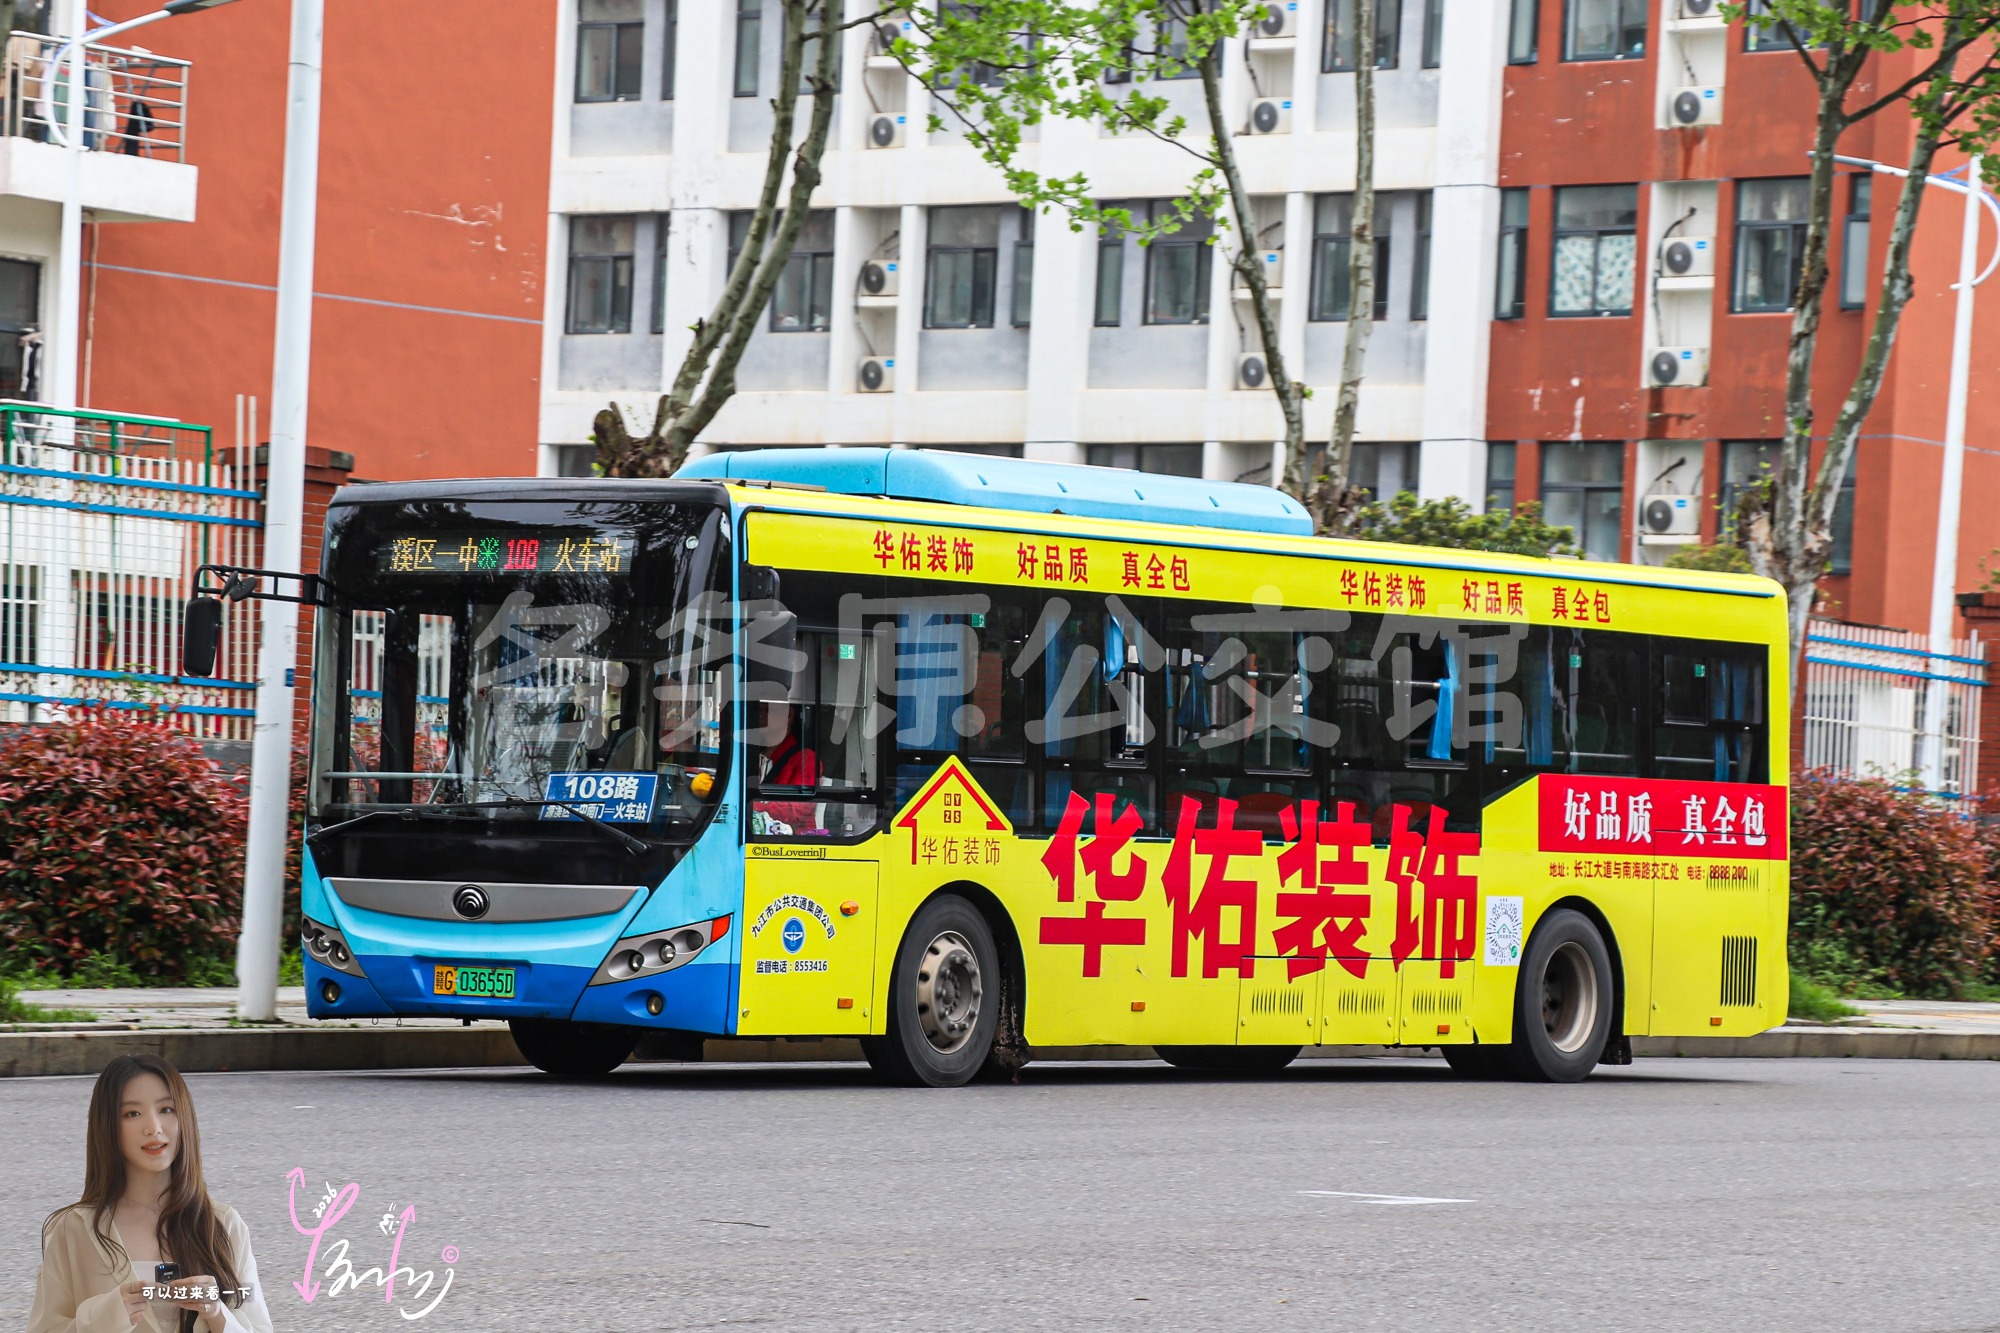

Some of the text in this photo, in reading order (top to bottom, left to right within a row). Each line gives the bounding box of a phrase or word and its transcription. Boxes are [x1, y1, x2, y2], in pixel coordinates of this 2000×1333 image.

[390, 537, 623, 572] 溪区一中 108 火车站
[873, 530, 1191, 592] 华佑装饰 好品质 真全包
[1340, 569, 1611, 623] 华佑装饰 好品质 真全包
[565, 776, 640, 800] 108路
[1563, 787, 1768, 847] 好品质 真全包
[921, 835, 1001, 866] 华佑装饰
[1040, 790, 1481, 983] 华佑装饰
[752, 895, 836, 939] 九江市公共交通集团公司
